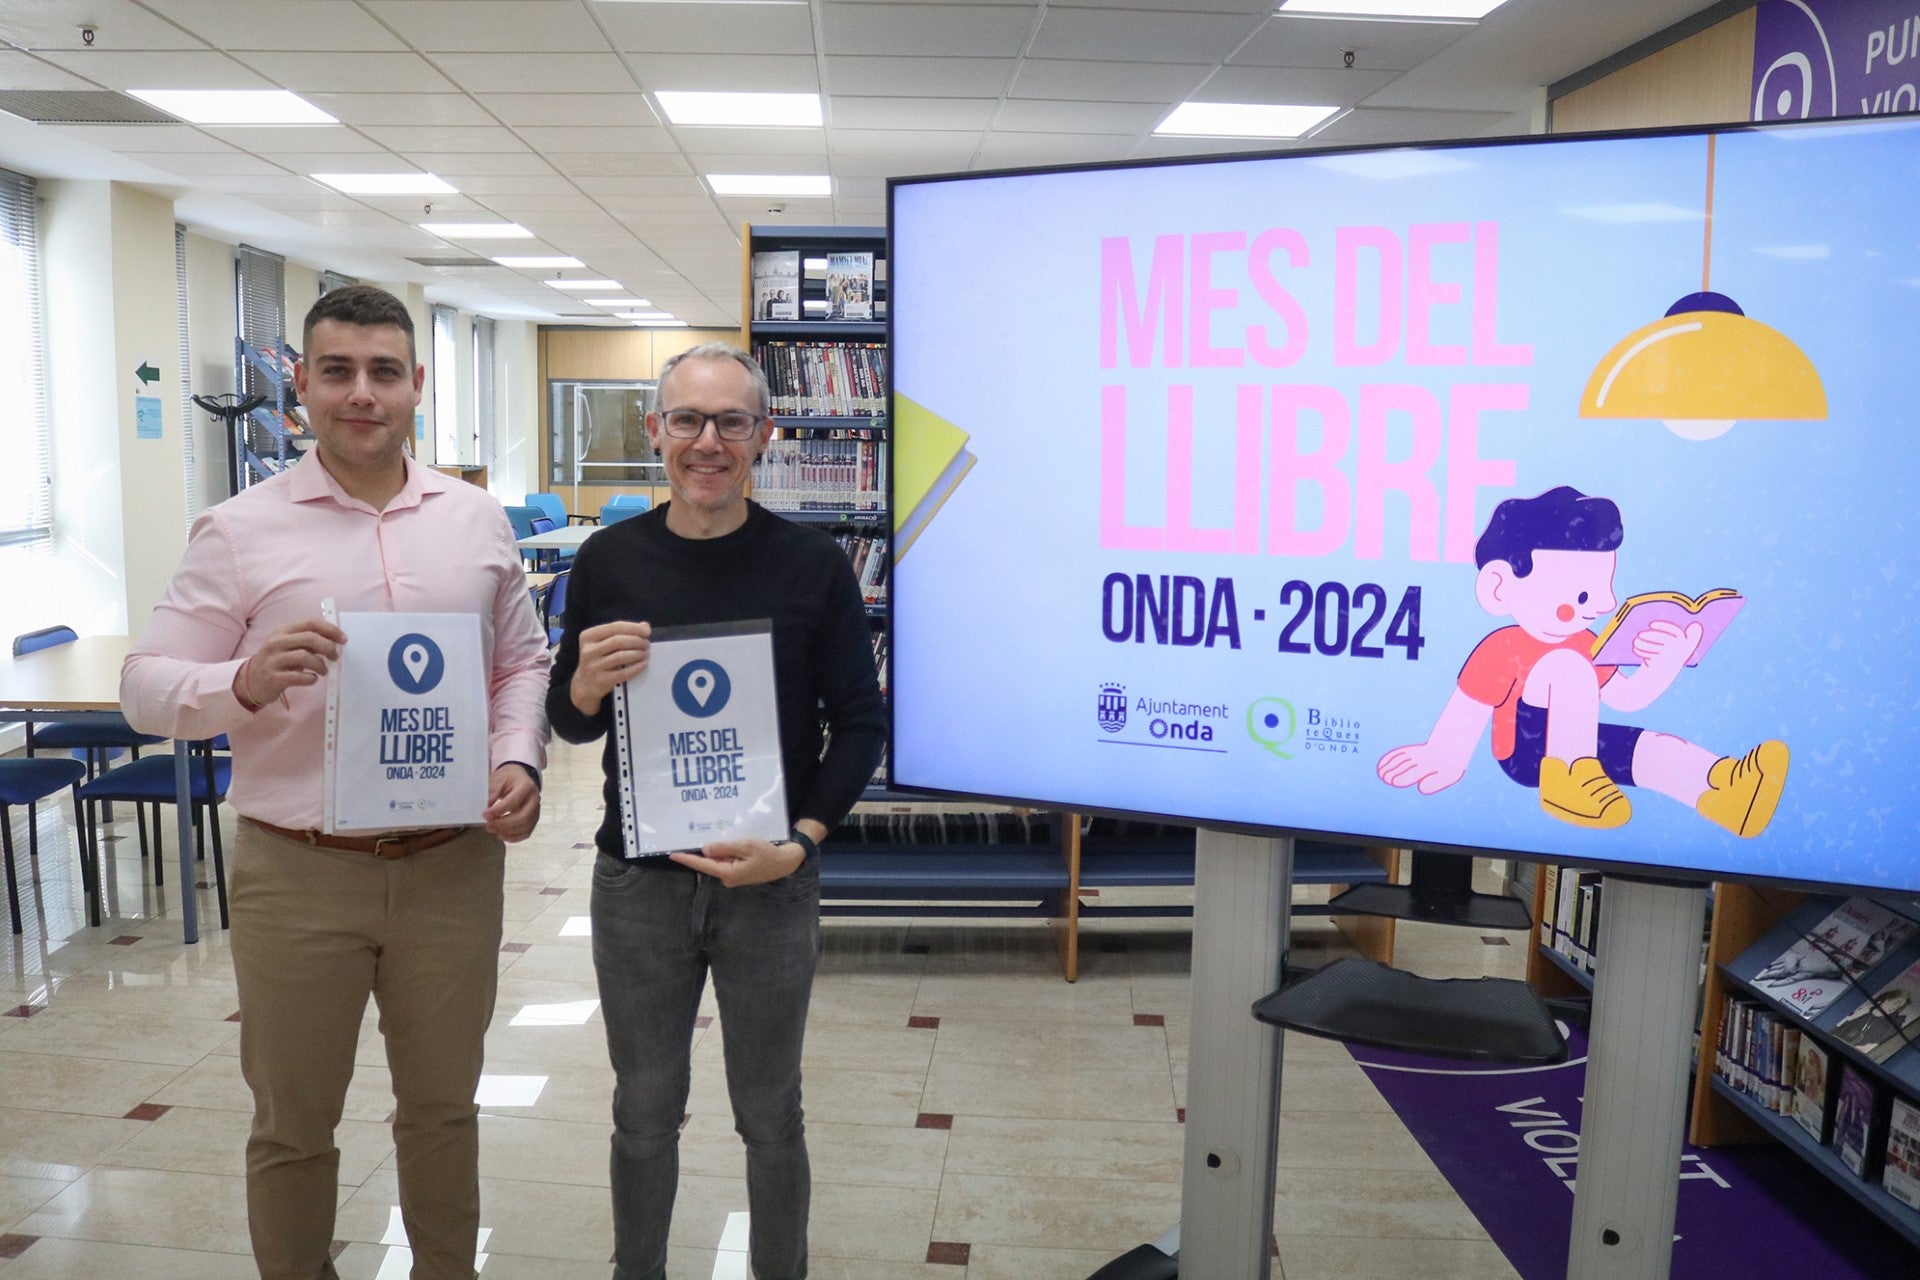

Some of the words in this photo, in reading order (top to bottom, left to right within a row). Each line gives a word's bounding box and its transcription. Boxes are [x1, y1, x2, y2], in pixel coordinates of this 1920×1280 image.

[1099, 228, 1310, 369] MES
[1333, 220, 1534, 367] DEL
[1099, 383, 1530, 564] LLIBRE
[1101, 572, 1242, 650] ONDA
[1278, 579, 1425, 661] 2024
[381, 708, 419, 732] MES
[423, 707, 454, 731] DEL
[1136, 697, 1229, 719] Ajuntament
[1307, 708, 1360, 729] Biblio
[668, 731, 707, 756] MES
[710, 728, 743, 752] DEL
[1149, 718, 1213, 742] Onda
[379, 734, 454, 764] LLIBRE
[386, 766, 413, 780] ONDA
[419, 766, 445, 779] 2024
[671, 753, 746, 787] LLIBRE
[681, 788, 708, 802] ONDA
[714, 786, 739, 800] 2024
